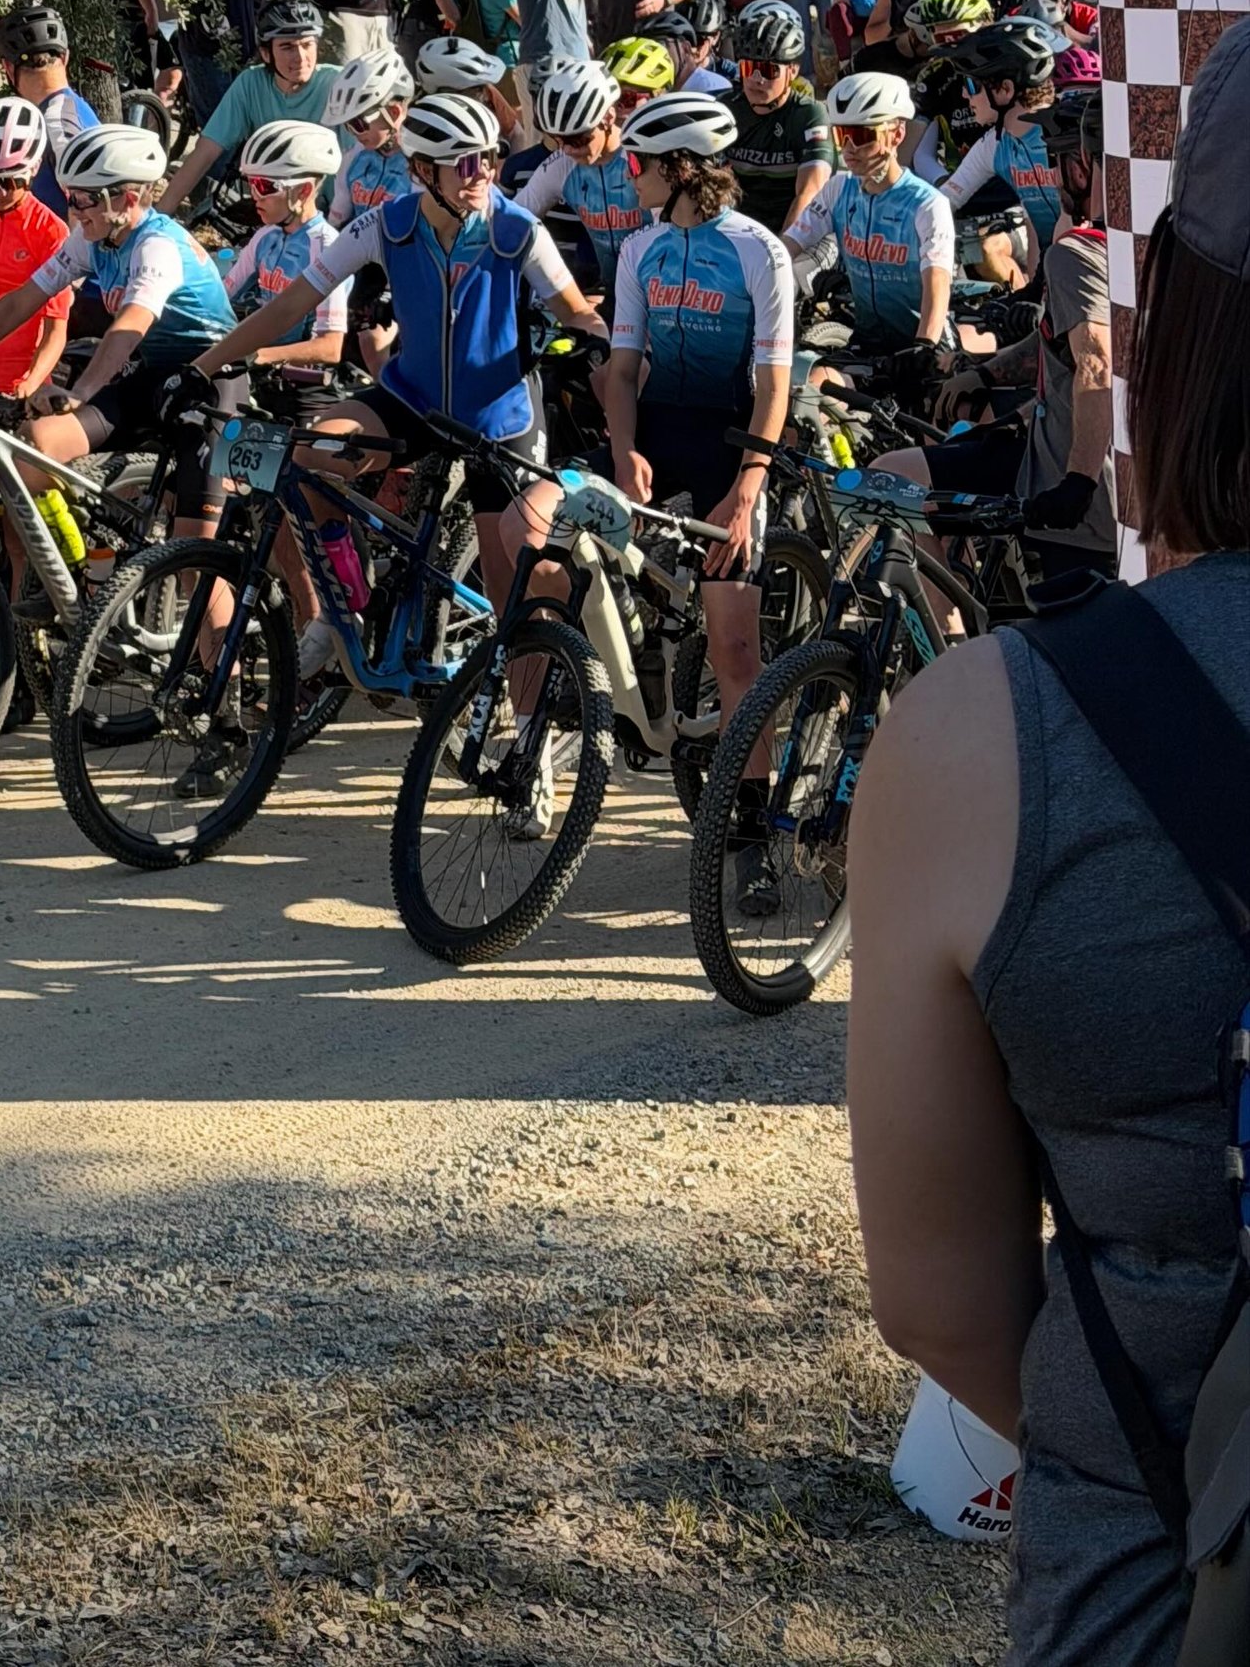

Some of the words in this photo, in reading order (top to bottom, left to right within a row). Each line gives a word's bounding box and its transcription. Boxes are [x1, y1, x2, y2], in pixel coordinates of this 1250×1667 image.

[729, 147, 795, 164] RIZZLIES
[231, 446, 263, 472] 263
[586, 492, 616, 526] 244
[469, 693, 492, 743] FOX
